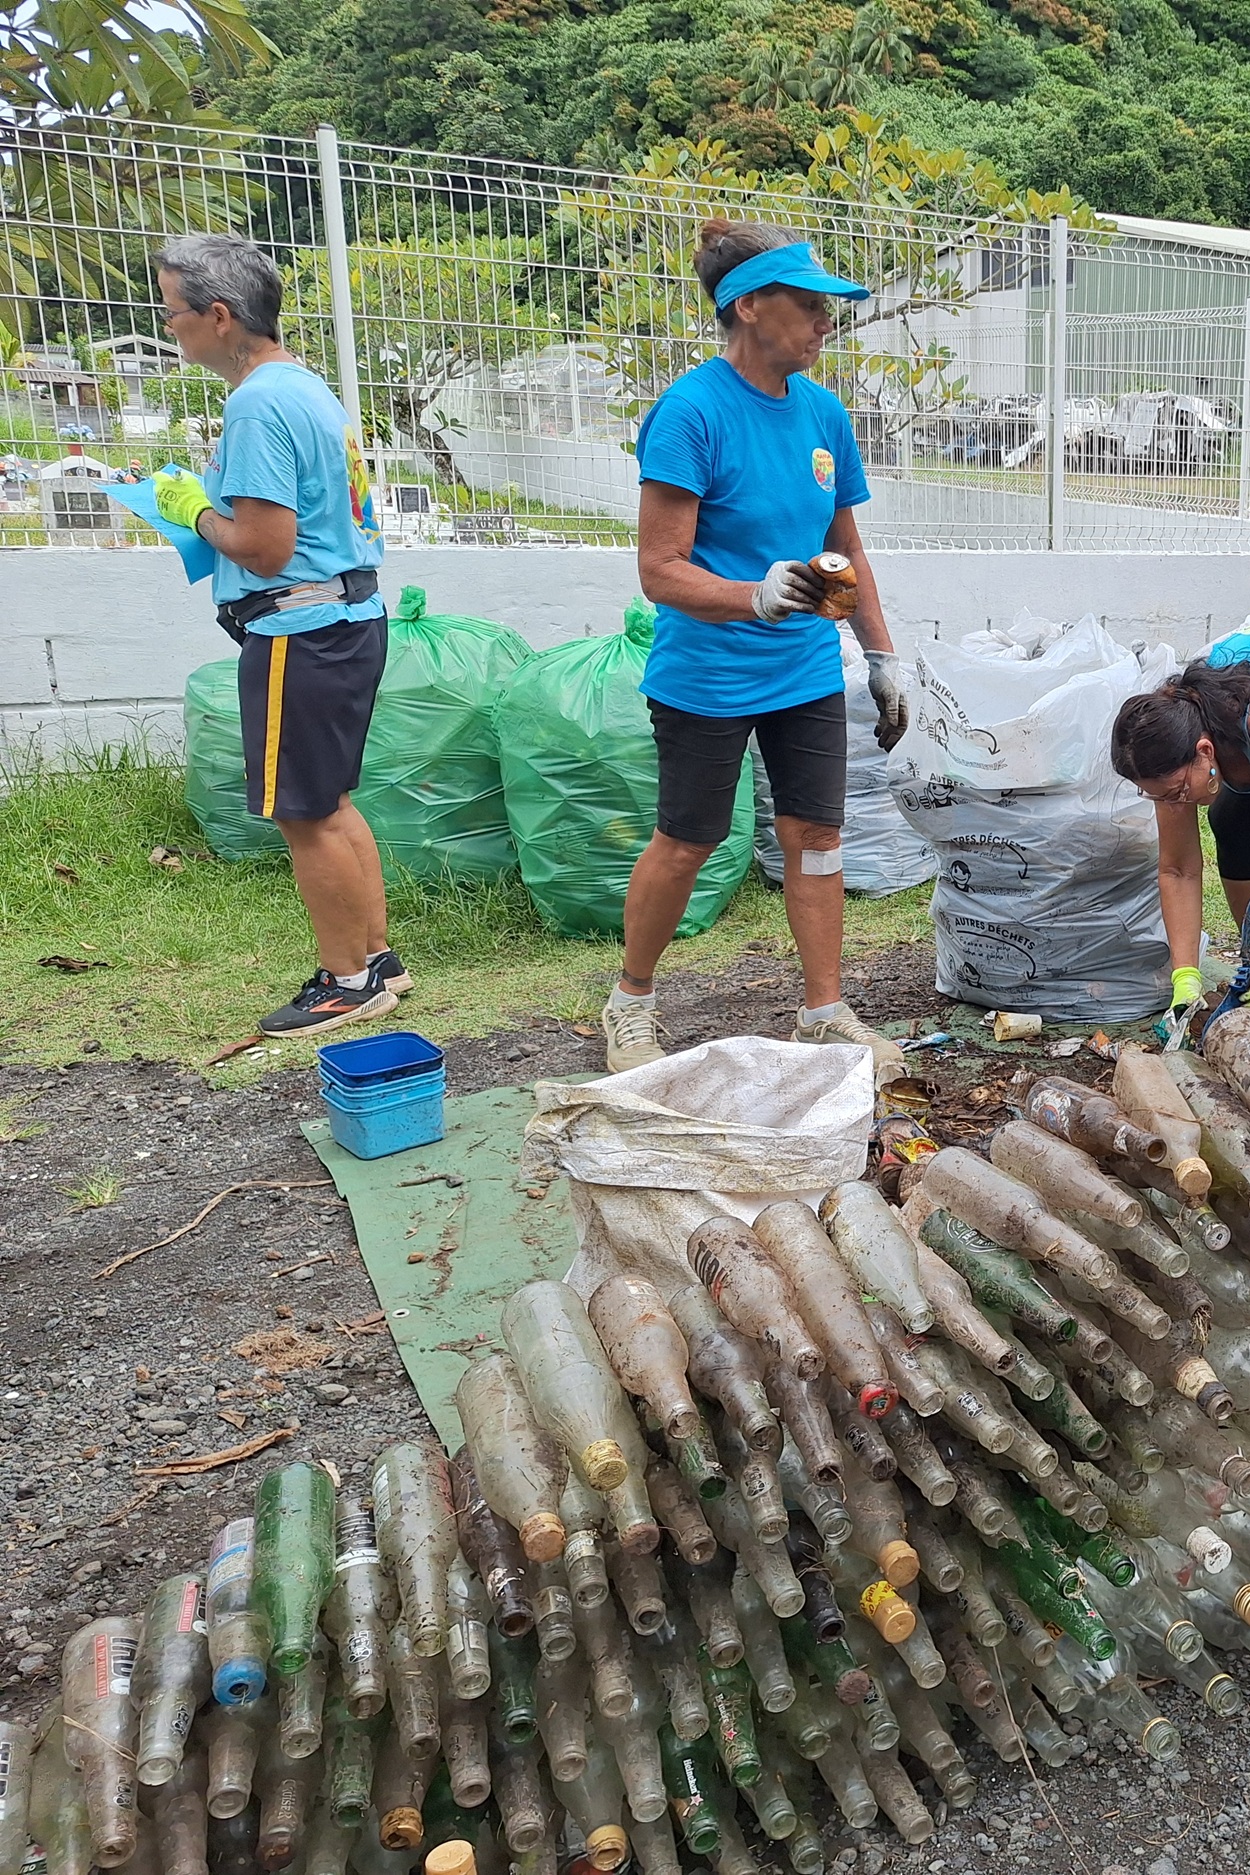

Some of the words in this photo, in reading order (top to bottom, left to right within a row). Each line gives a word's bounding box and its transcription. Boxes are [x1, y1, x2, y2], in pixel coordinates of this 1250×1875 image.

[955, 917, 986, 931] AUTRES
[987, 923, 1036, 951] DÉCHETS
[682, 1758, 699, 1795] Heineken
[277, 1778, 296, 1820] CRUISER
